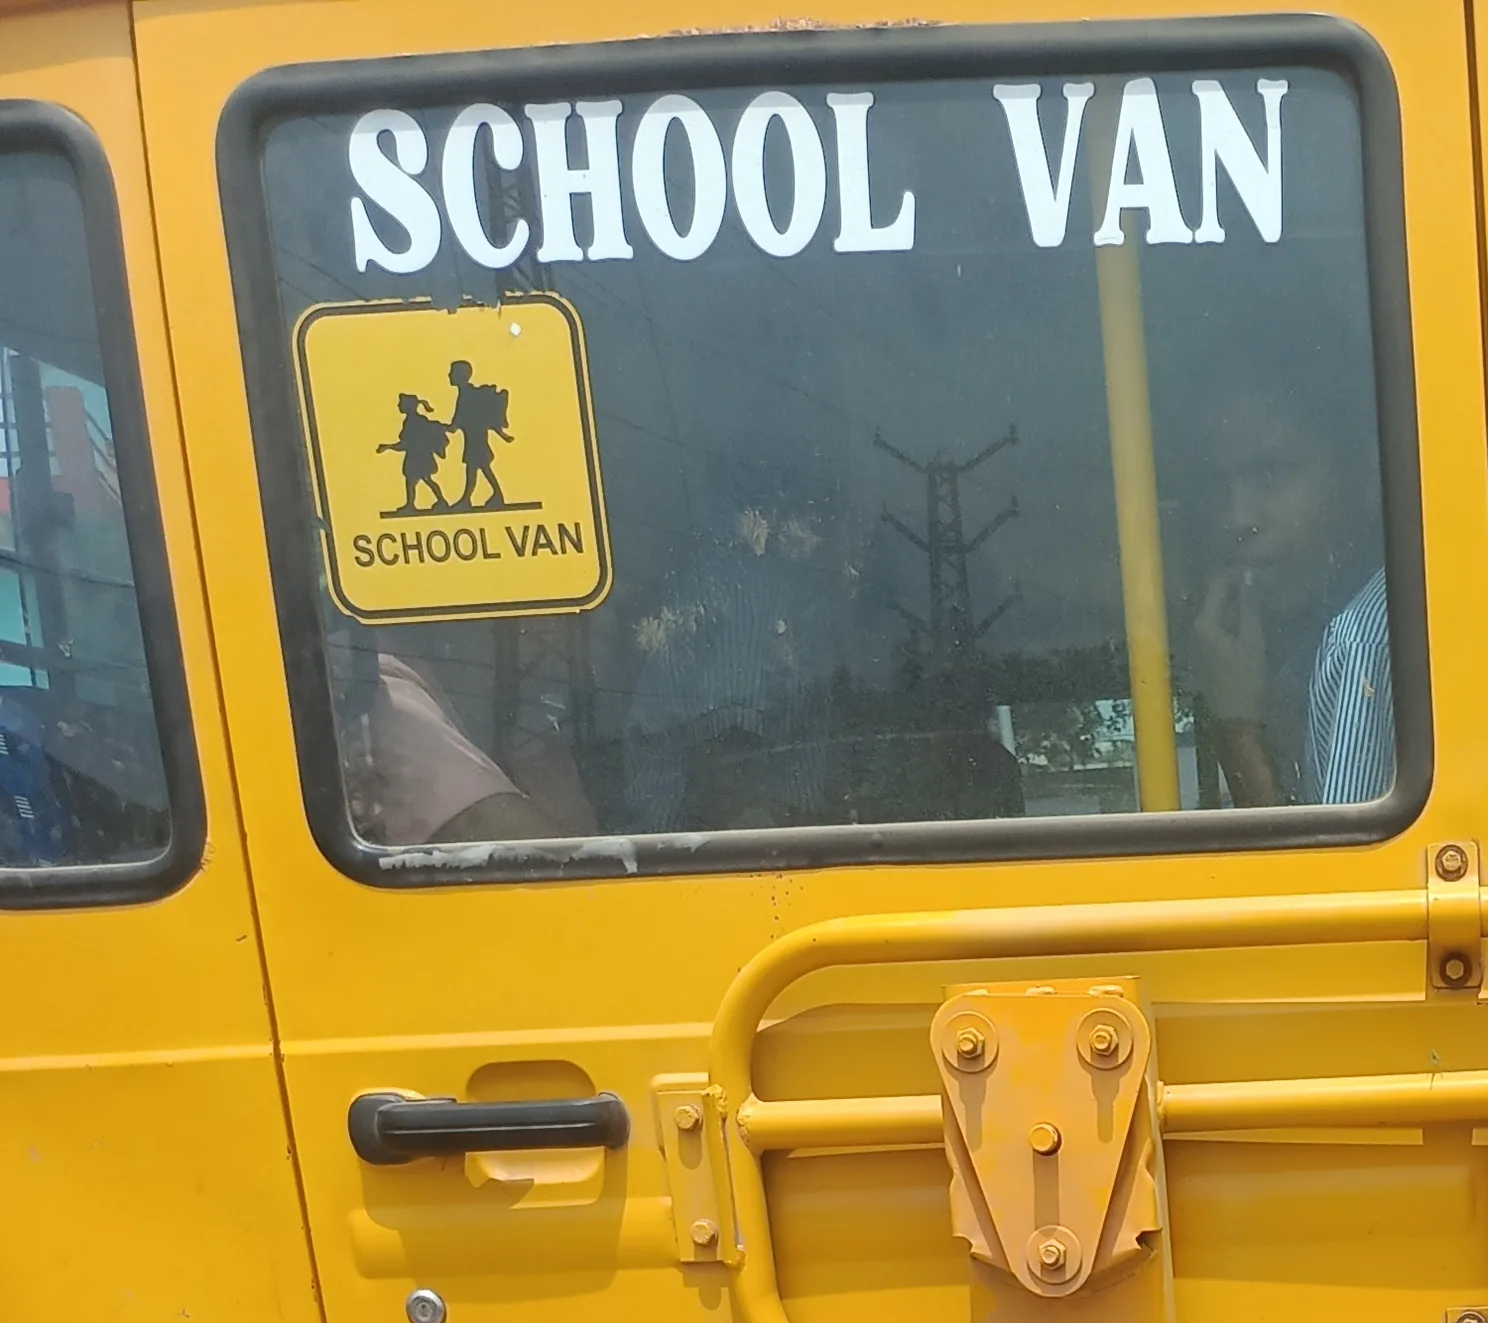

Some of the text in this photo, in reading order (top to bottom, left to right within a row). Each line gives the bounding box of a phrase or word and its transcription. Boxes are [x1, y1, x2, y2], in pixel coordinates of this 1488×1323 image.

[348, 77, 1289, 274] SCHOOL VAN
[353, 522, 585, 568] SCHOOL VAN
